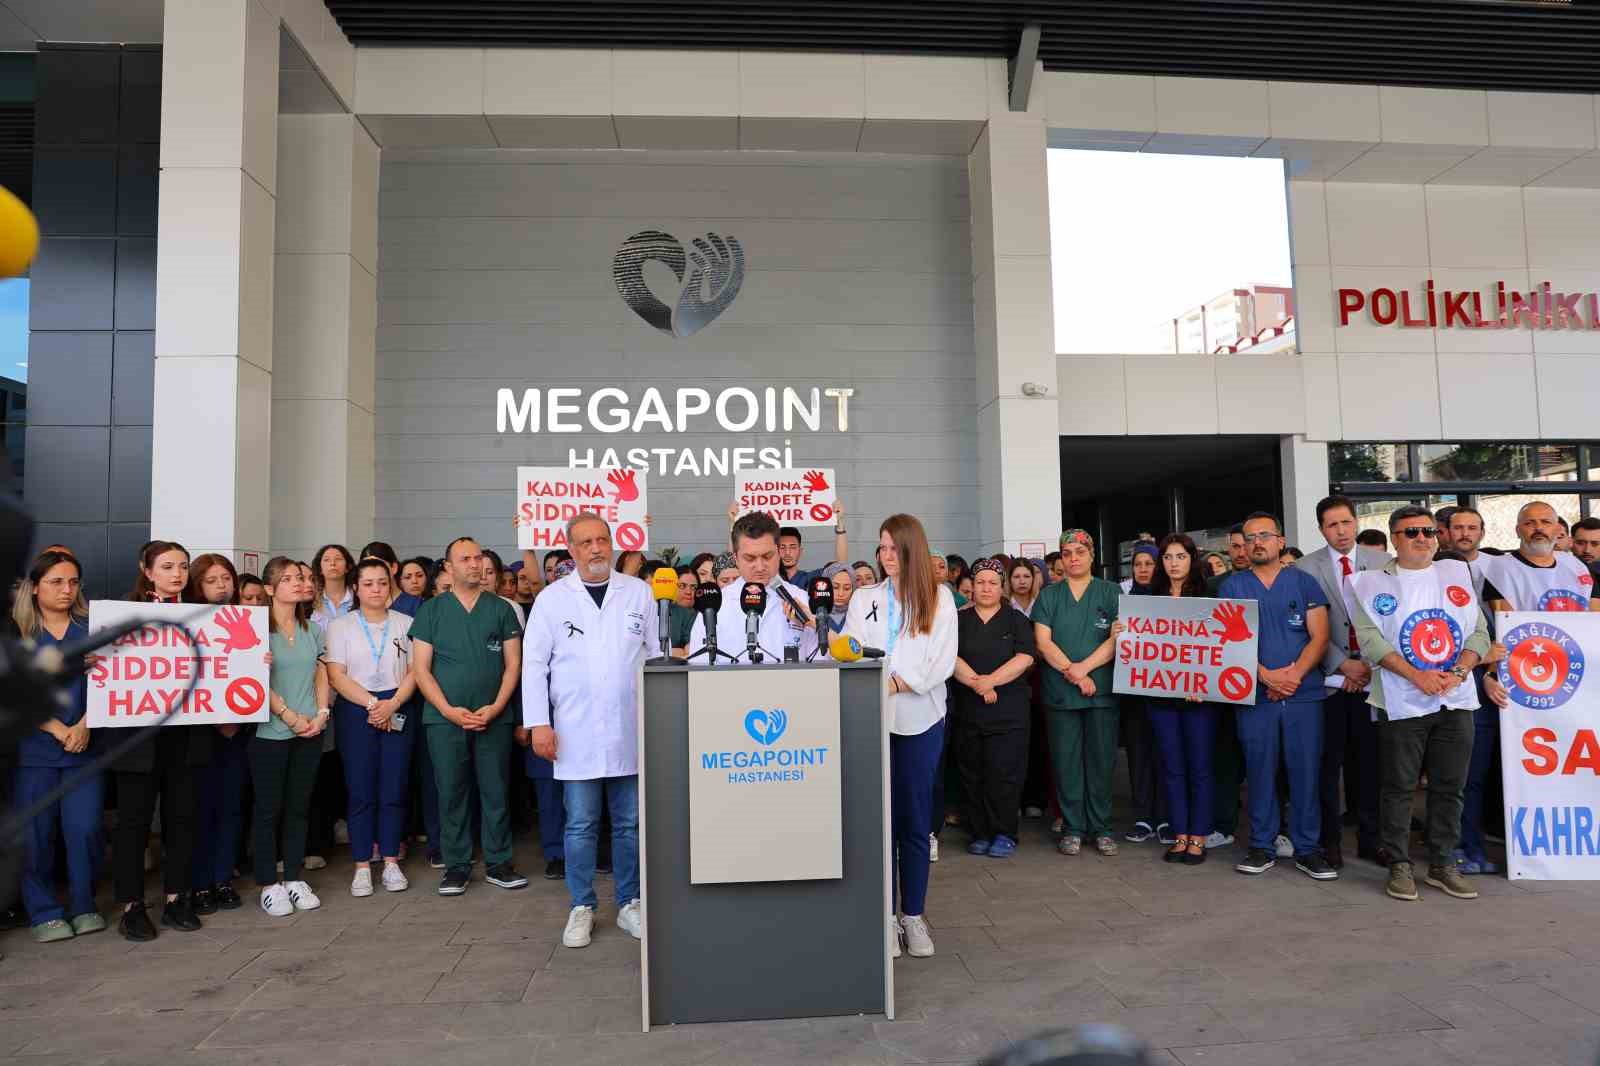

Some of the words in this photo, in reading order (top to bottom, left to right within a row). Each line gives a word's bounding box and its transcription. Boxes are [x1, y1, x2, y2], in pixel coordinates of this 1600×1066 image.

[496, 387, 854, 433] MEGAPOINT
[568, 439, 793, 476] HASTANESİ
[527, 480, 605, 498] KADINA
[741, 492, 812, 509] ŞİDDETE
[744, 481, 802, 492] KADINA
[1128, 616, 1211, 638] KADINA
[1119, 635, 1224, 667] ŞİDDETE
[1507, 623, 1570, 647] SAĞLIK
[1562, 661, 1582, 694] SEN
[91, 648, 229, 689] ŞİDDETE
[1129, 667, 1209, 695] HAYIR
[108, 688, 215, 717] HAYIR
[1524, 694, 1557, 708] 1992
[702, 747, 828, 769] MEGAPOINT
[1511, 805, 1600, 857] KAHR
